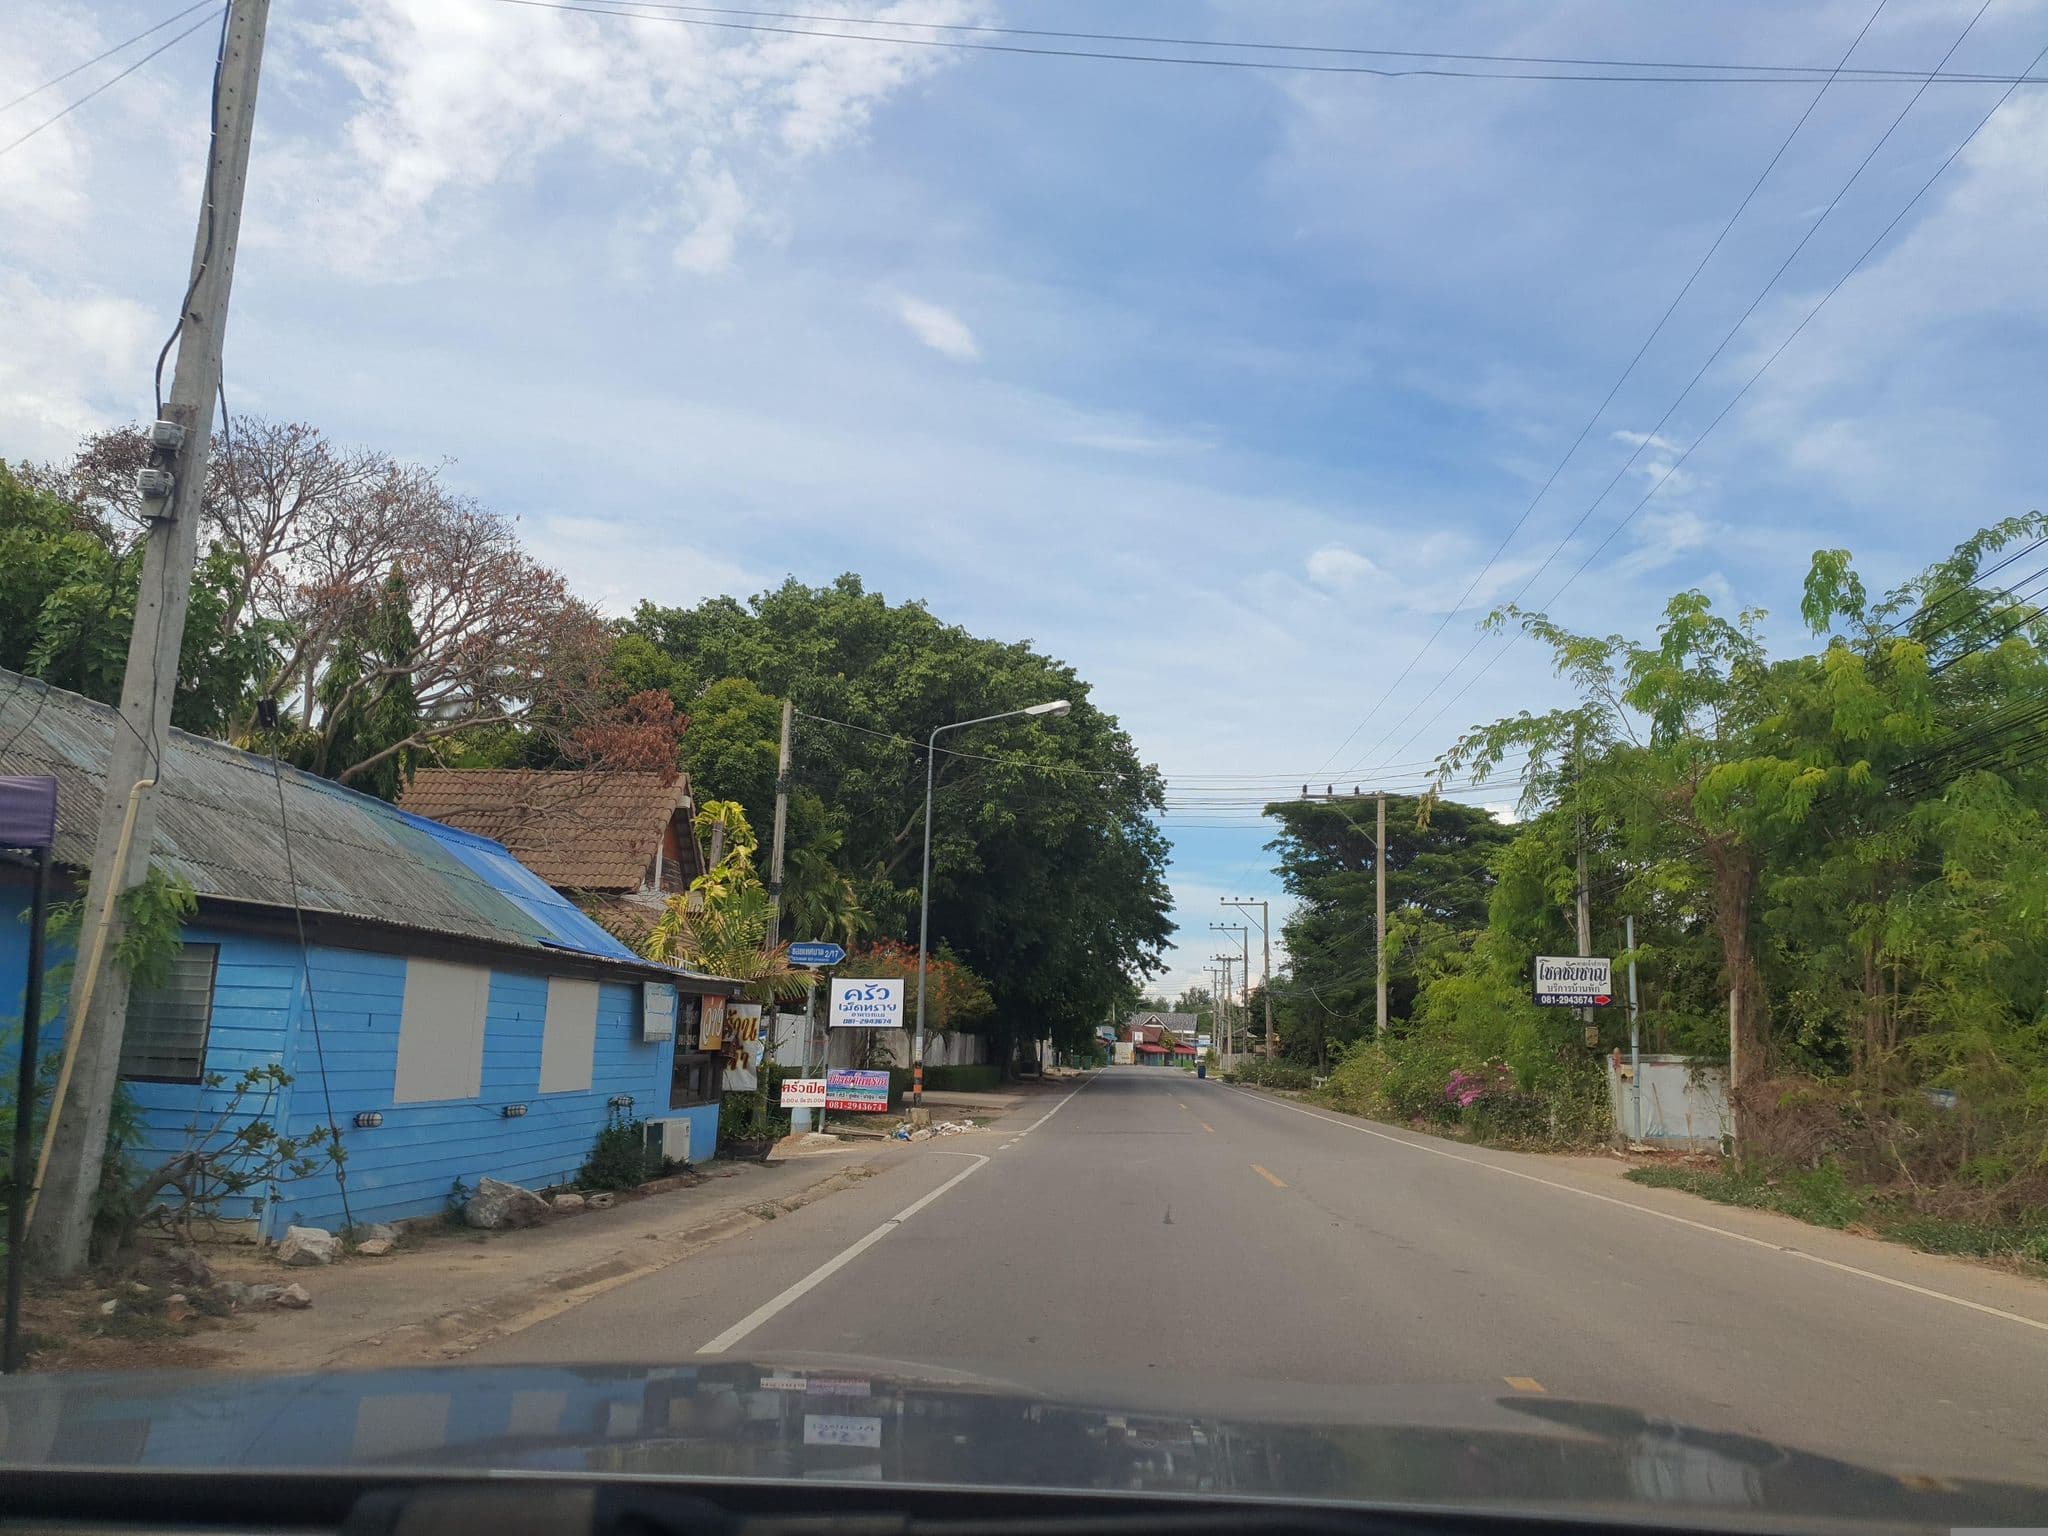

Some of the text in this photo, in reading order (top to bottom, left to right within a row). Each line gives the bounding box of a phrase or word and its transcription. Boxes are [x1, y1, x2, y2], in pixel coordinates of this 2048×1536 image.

[1539, 959, 1607, 987] โชคชัยชาญ
[844, 983, 891, 1001] ครัว
[1547, 983, 1600, 993] บริการบ้านพัก
[1541, 995, 1593, 1004] 081-2943674
[838, 1001, 897, 1012] เม็ดทราย
[783, 1080, 826, 1094] ครัวเปิด
[829, 1101, 882, 1111] 081-2943674
